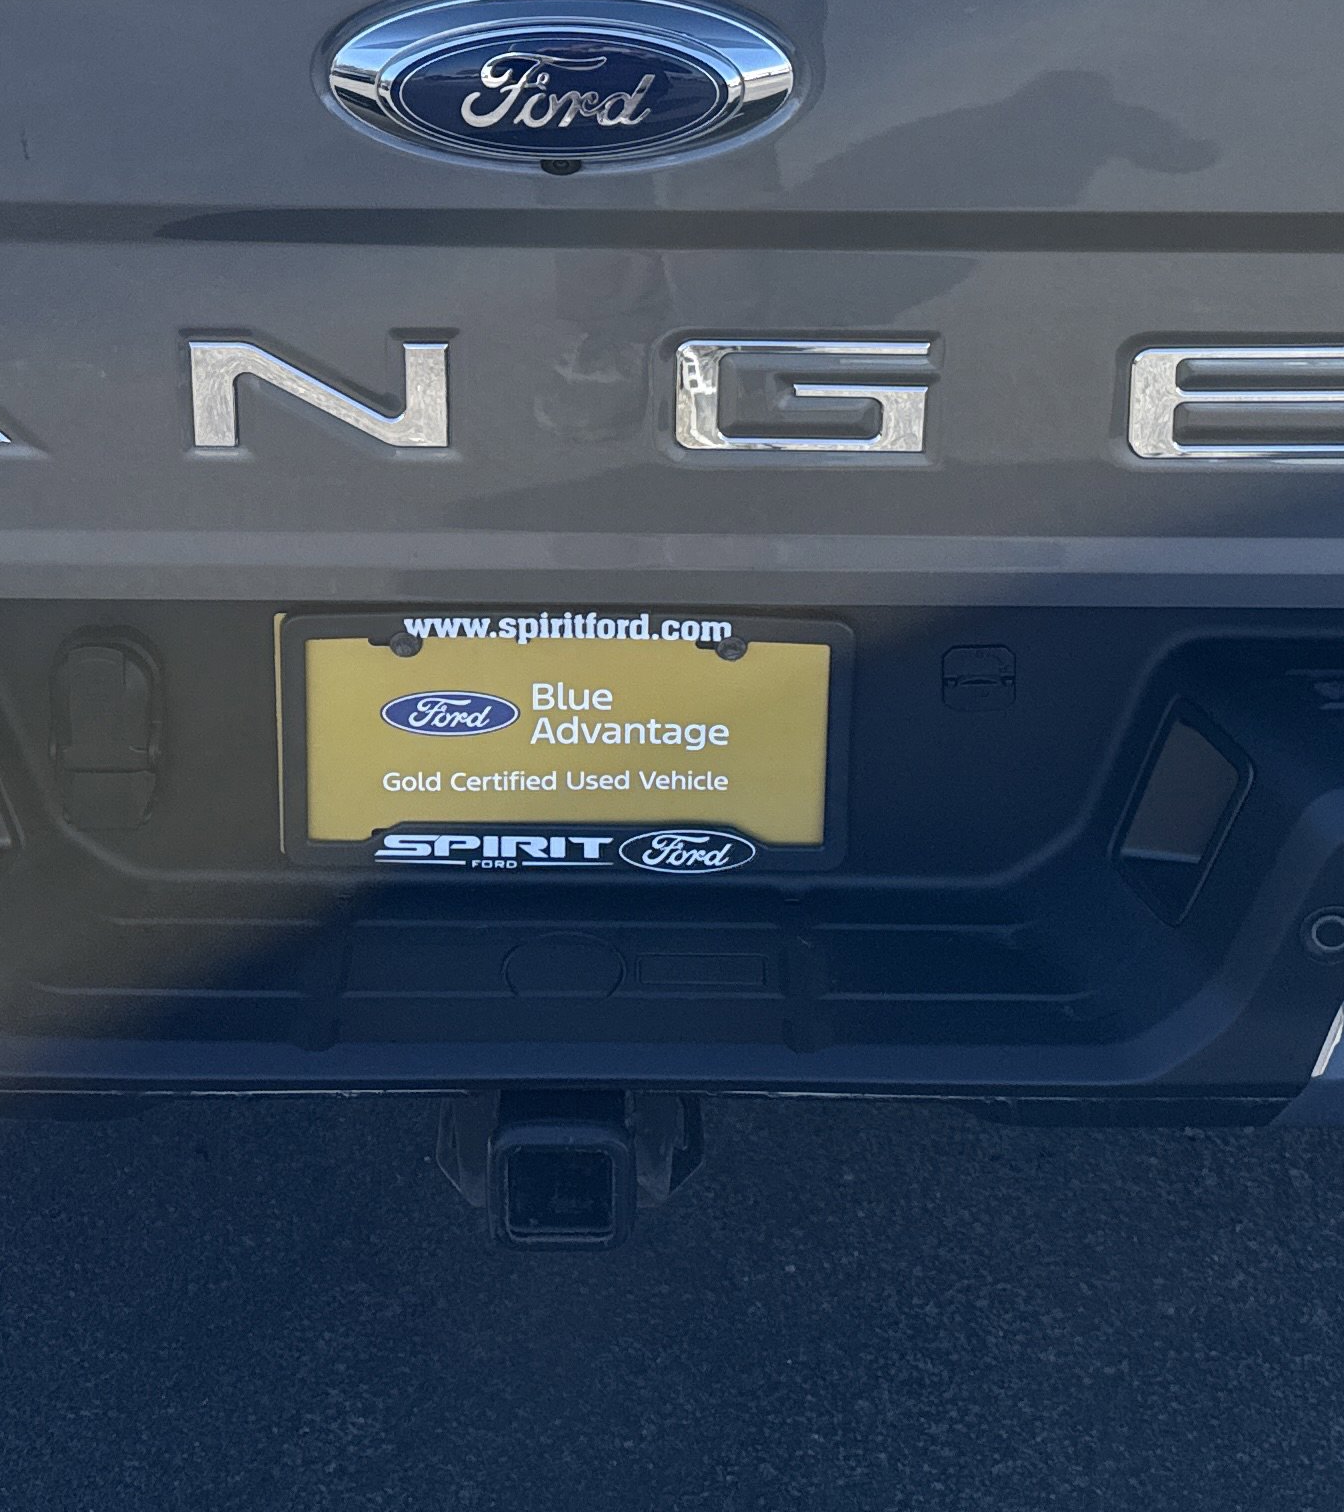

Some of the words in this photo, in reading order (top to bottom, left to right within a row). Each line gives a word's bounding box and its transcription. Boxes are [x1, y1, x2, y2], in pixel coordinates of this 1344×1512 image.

[461, 51, 655, 128] Ford
[403, 612, 732, 644] www.spiritford.com
[532, 682, 613, 711] Blue
[408, 697, 491, 730] Ford
[530, 716, 730, 750] Advantage
[382, 771, 441, 792] Gold
[450, 770, 557, 792] Certified
[566, 771, 630, 791] Used
[638, 769, 729, 791] Vehicle
[374, 834, 614, 859] SPIRIT
[642, 834, 731, 866] Ford
[471, 859, 518, 869] FORD
